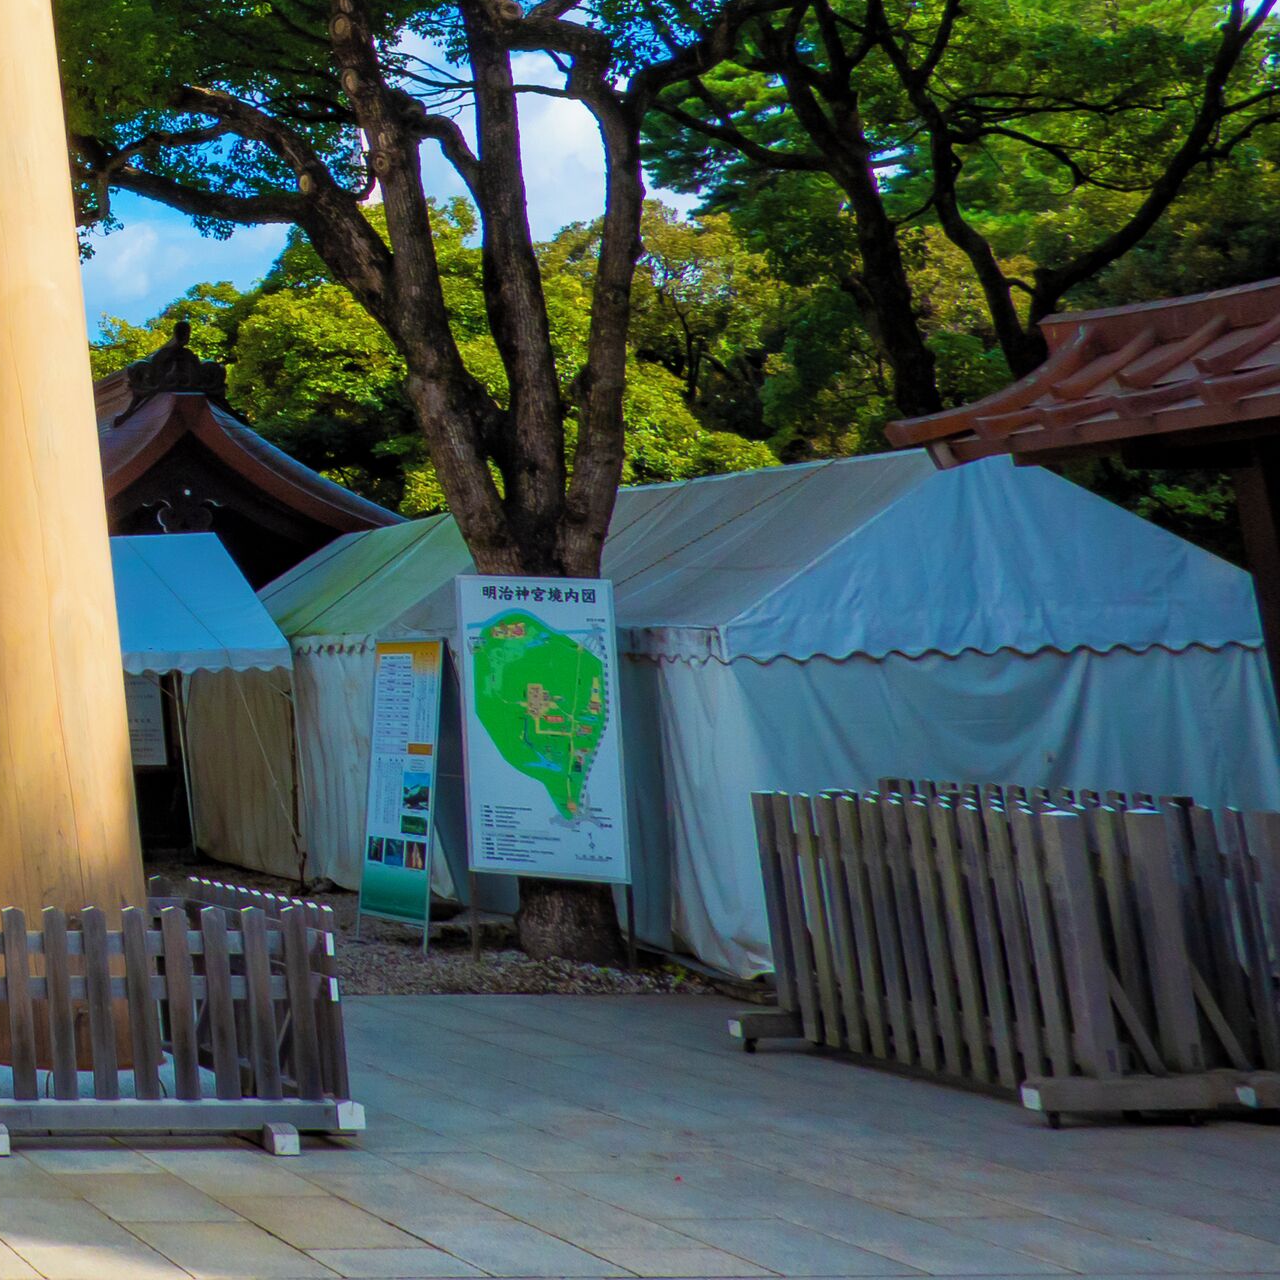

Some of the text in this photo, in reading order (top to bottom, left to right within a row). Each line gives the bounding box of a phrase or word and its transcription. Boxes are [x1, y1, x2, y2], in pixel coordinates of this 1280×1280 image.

[482, 585, 596, 603] 明治神宮境内図
